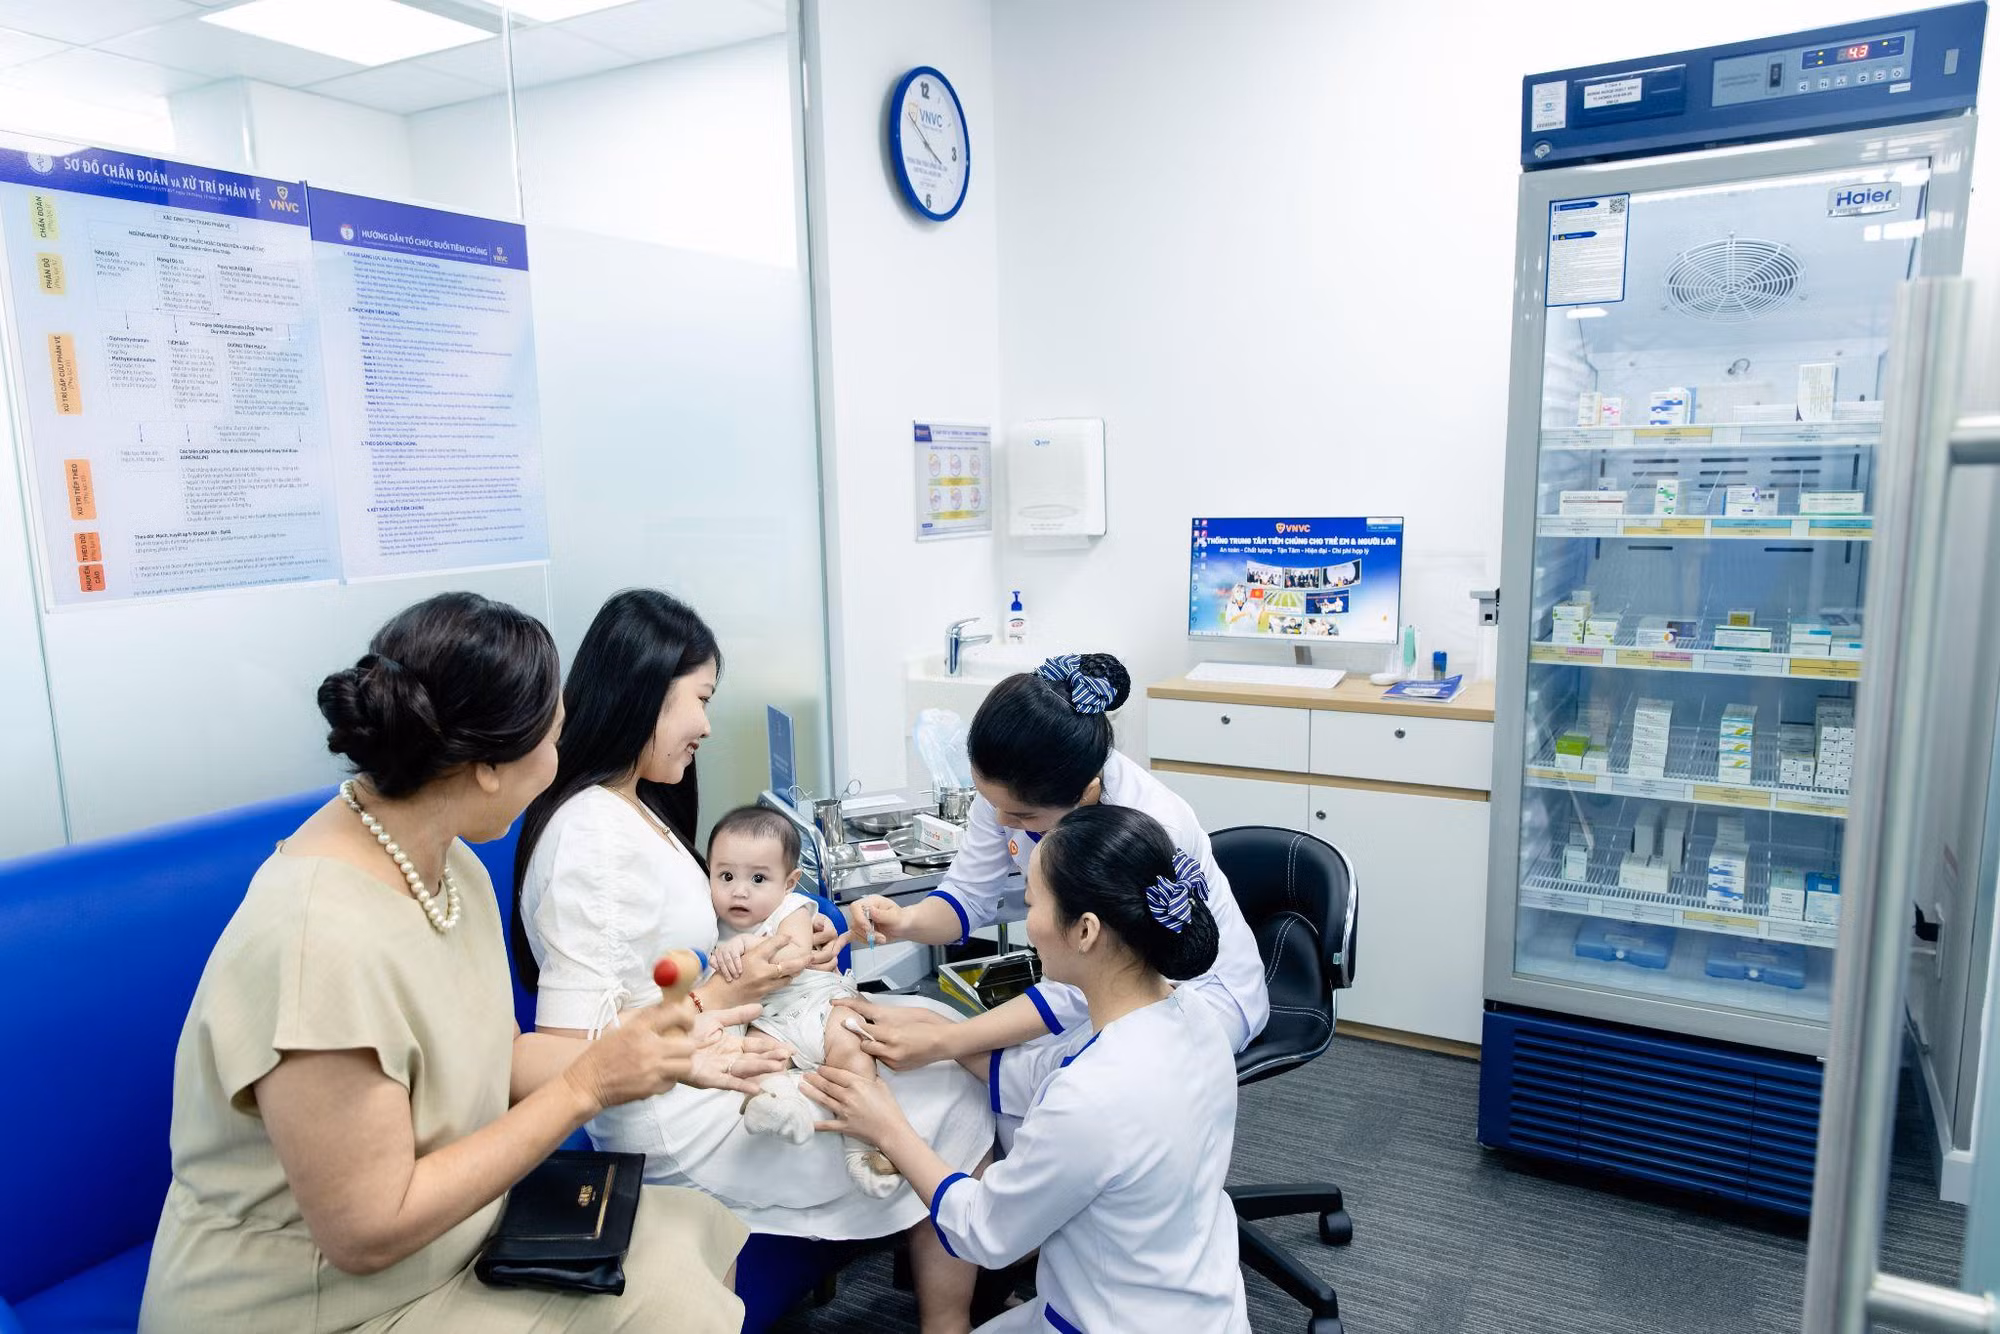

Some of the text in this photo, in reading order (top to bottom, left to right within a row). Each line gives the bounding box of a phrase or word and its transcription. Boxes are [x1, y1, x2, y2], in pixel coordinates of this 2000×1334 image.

[920, 81, 930, 100] 12
[920, 108, 942, 128] VNVC
[952, 146, 957, 162] 3
[64, 157, 80, 172] SƠ
[82, 159, 100, 174] ĐỒ
[102, 163, 135, 180] CHẨN
[137, 169, 169, 186] ĐOÁN
[182, 174, 196, 190] XỬ
[199, 180, 216, 194] TRÍ
[218, 182, 247, 200] PHẢN
[248, 187, 262, 204] VỆ
[926, 194, 932, 208] 6
[1836, 188, 1892, 206] Haier
[269, 198, 300, 214] VNVC
[361, 229, 388, 240] HƯỚNG
[389, 232, 405, 243] DẪN
[414, 237, 434, 248] CHỨC
[434, 240, 450, 250] BUỔI
[450, 243, 465, 253] TIÊM
[466, 246, 488, 256] CHỦNG
[1286, 524, 1310, 532] VNVC
[1207, 536, 1228, 544] THỐNG
[1253, 536, 1267, 545] TÂM
[1268, 536, 1284, 545] TIÊM
[1285, 536, 1308, 545] CHỦNG
[1324, 536, 1338, 545] TRẺ
[1358, 537, 1381, 545] NGƯỜI
[1381, 537, 1396, 545] LỚN
